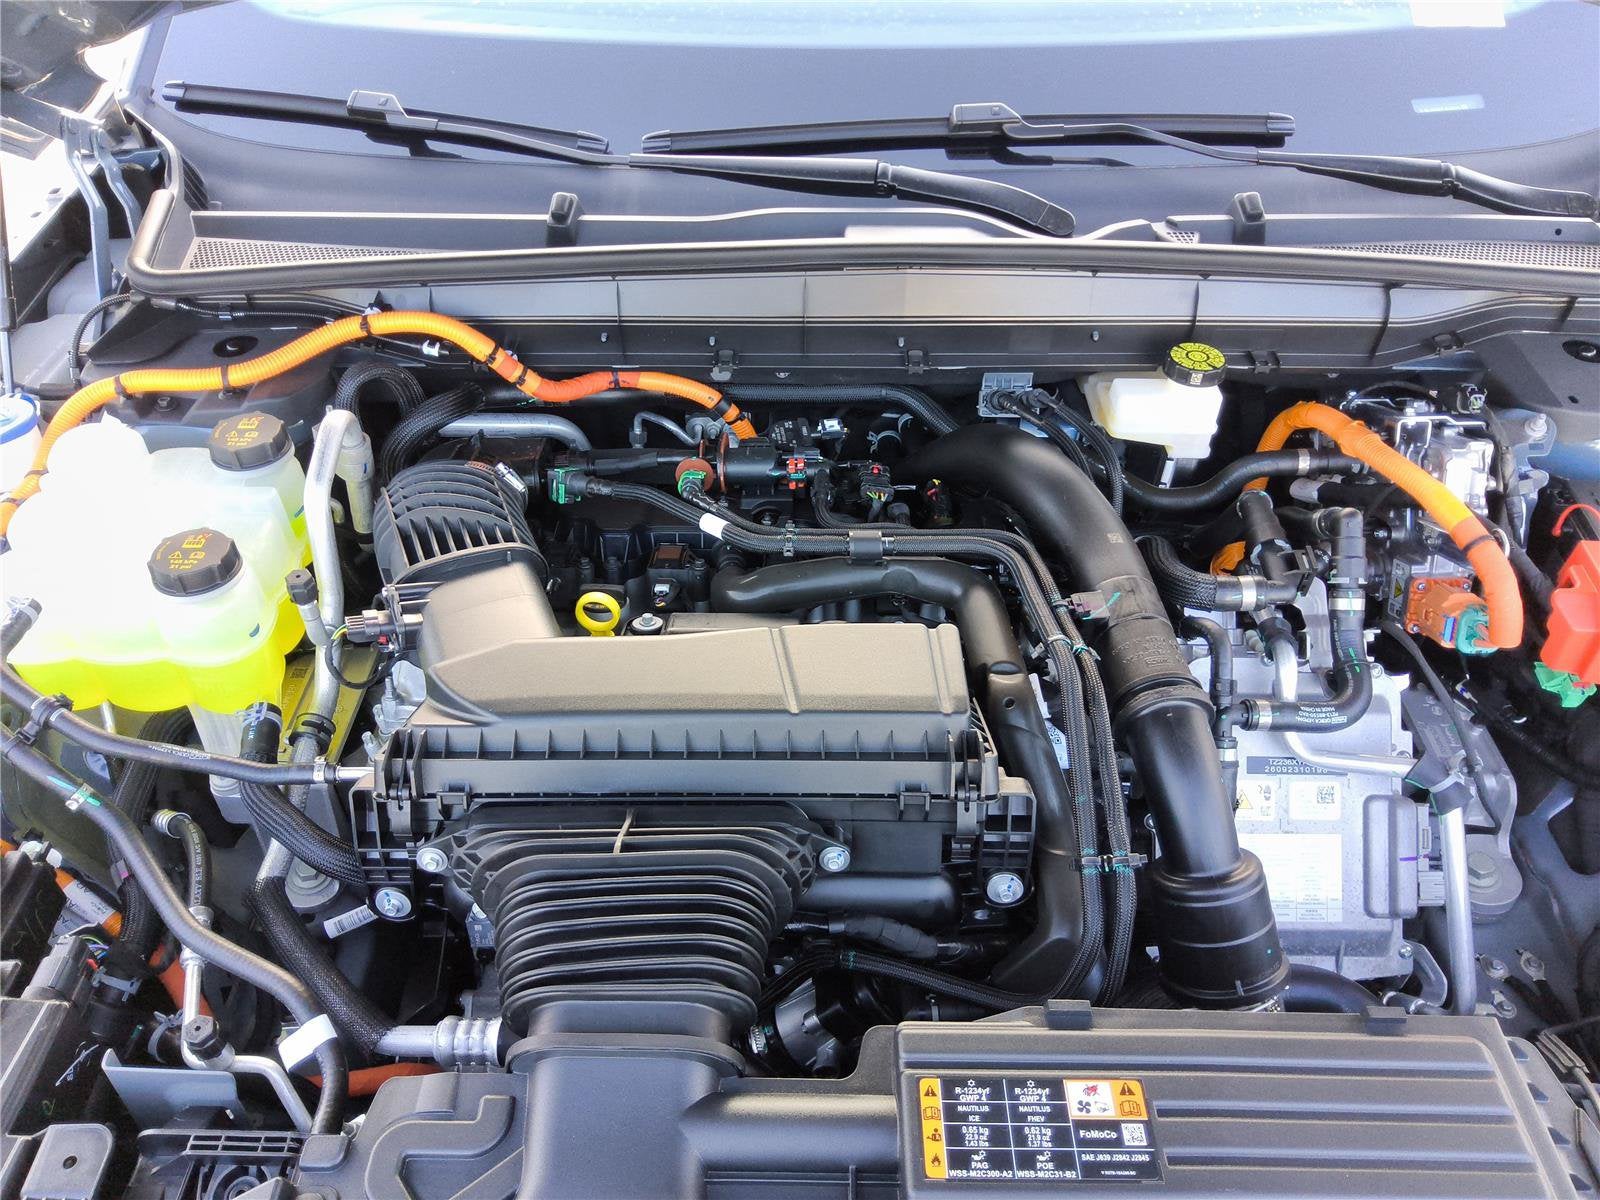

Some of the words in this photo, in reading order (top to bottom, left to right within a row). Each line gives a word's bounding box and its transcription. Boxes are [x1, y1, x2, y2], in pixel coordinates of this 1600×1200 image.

[955, 1087, 990, 1096] R-1234yf
[1014, 1088, 1050, 1097] R-1234yf
[962, 1126, 979, 1134] 0.65
[979, 1126, 989, 1136] kg
[1041, 1127, 1051, 1136] kg
[1079, 1129, 1117, 1139] FoMoCo
[1081, 1153, 1095, 1161] SAE
[949, 1170, 1013, 1178] WSS-M2C300-A2
